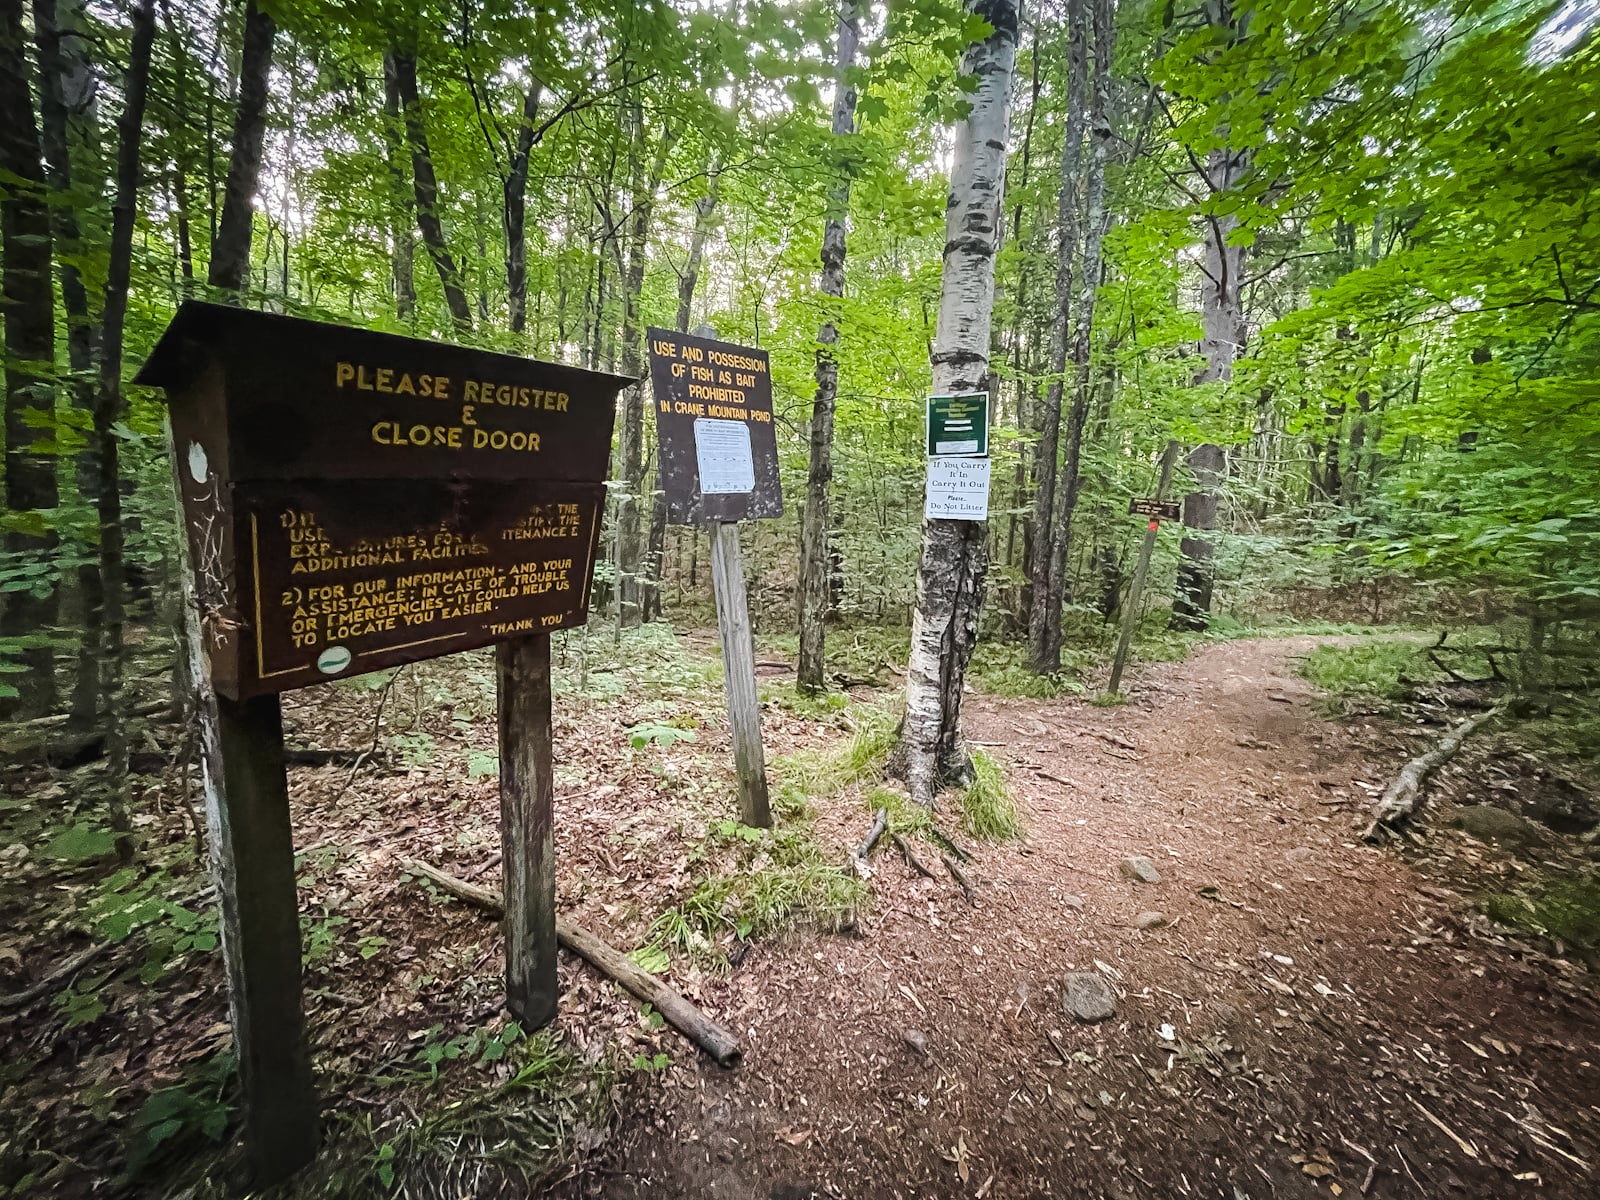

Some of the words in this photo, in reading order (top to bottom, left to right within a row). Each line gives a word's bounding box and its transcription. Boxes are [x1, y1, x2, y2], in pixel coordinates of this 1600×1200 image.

[653, 340, 677, 357] USE
[682, 345, 704, 362] AND
[708, 351, 766, 372] POSSESSION
[336, 361, 450, 399] PLEASE
[463, 380, 570, 412] REGISTER
[671, 363, 686, 378] OF
[691, 365, 714, 382] FISH
[718, 370, 732, 385] AS
[736, 373, 756, 388] BAIT
[688, 383, 746, 404] PROHIBITED
[660, 400, 671, 413] IN
[675, 401, 705, 416] CRANE
[708, 404, 748, 420] MOUNTAIN
[750, 411, 771, 423] POND
[371, 422, 463, 449] CLOSE
[473, 428, 541, 451] DOOR
[944, 461, 959, 469] You
[960, 462, 987, 470] Carry
[932, 480, 957, 488] Carry
[558, 504, 579, 514] THE
[560, 515, 581, 527] THE
[291, 551, 405, 575] ADDITIONAL
[282, 587, 303, 606] 2)
[308, 585, 345, 601] FOR
[353, 579, 387, 594] OUR
[396, 566, 496, 589] INFORMATION
[509, 562, 538, 576] AND
[544, 559, 572, 574] YOUR
[423, 586, 438, 598] IN
[443, 579, 483, 595] CASE
[489, 576, 507, 589] OF
[514, 570, 568, 586] TROUBLE
[291, 618, 318, 634] OR
[327, 598, 444, 628] EMERGENCIES
[458, 594, 471, 605] IT
[476, 586, 519, 603] COULD
[523, 582, 553, 596] HELP
[556, 580, 571, 592] US
[291, 633, 318, 649] TO
[327, 617, 396, 642] LOCATE
[404, 611, 435, 627] YOU
